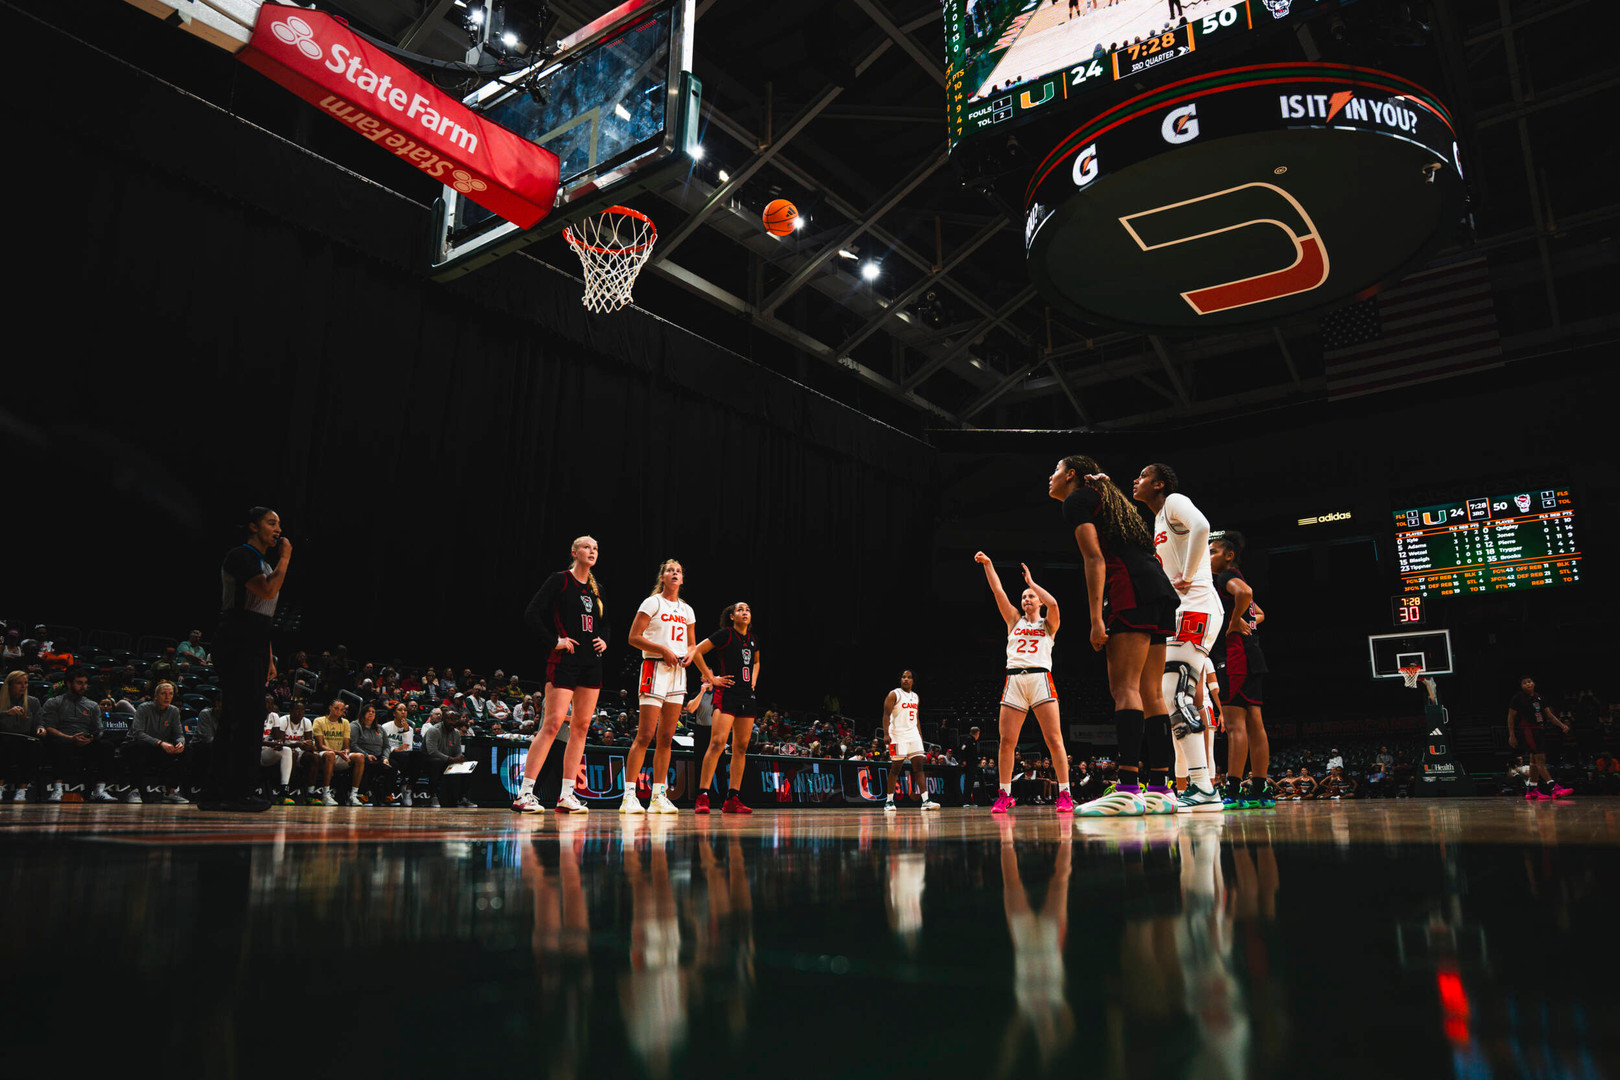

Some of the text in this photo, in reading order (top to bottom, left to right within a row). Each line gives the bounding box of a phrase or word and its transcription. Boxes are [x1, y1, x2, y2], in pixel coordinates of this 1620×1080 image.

[1202, 7, 1238, 34] 50
[1128, 32, 1175, 60] 7:28
[1132, 50, 1174, 73] 3RD QUARTER
[952, 68, 964, 82] PTS
[1071, 60, 1103, 85] 24
[954, 80, 962, 91] 10
[956, 104, 961, 113] 9
[968, 105, 992, 121] FOULS
[978, 117, 992, 128] TOL
[1161, 103, 1200, 144] G
[1369, 100, 1417, 134] YOU?
[957, 127, 962, 136] 7
[1072, 144, 1098, 186] G
[1450, 508, 1465, 517] 24
[1493, 502, 1508, 511] 50
[1318, 512, 1352, 523] adidas
[1401, 596, 1420, 606] 7:28
[1399, 606, 1419, 622] 30
[581, 614, 593, 633] 18
[672, 626, 684, 641] 12
[1014, 628, 1045, 637] CANES
[1016, 639, 1039, 653] 23
[742, 666, 750, 682] 0
[910, 711, 914, 721] 5
